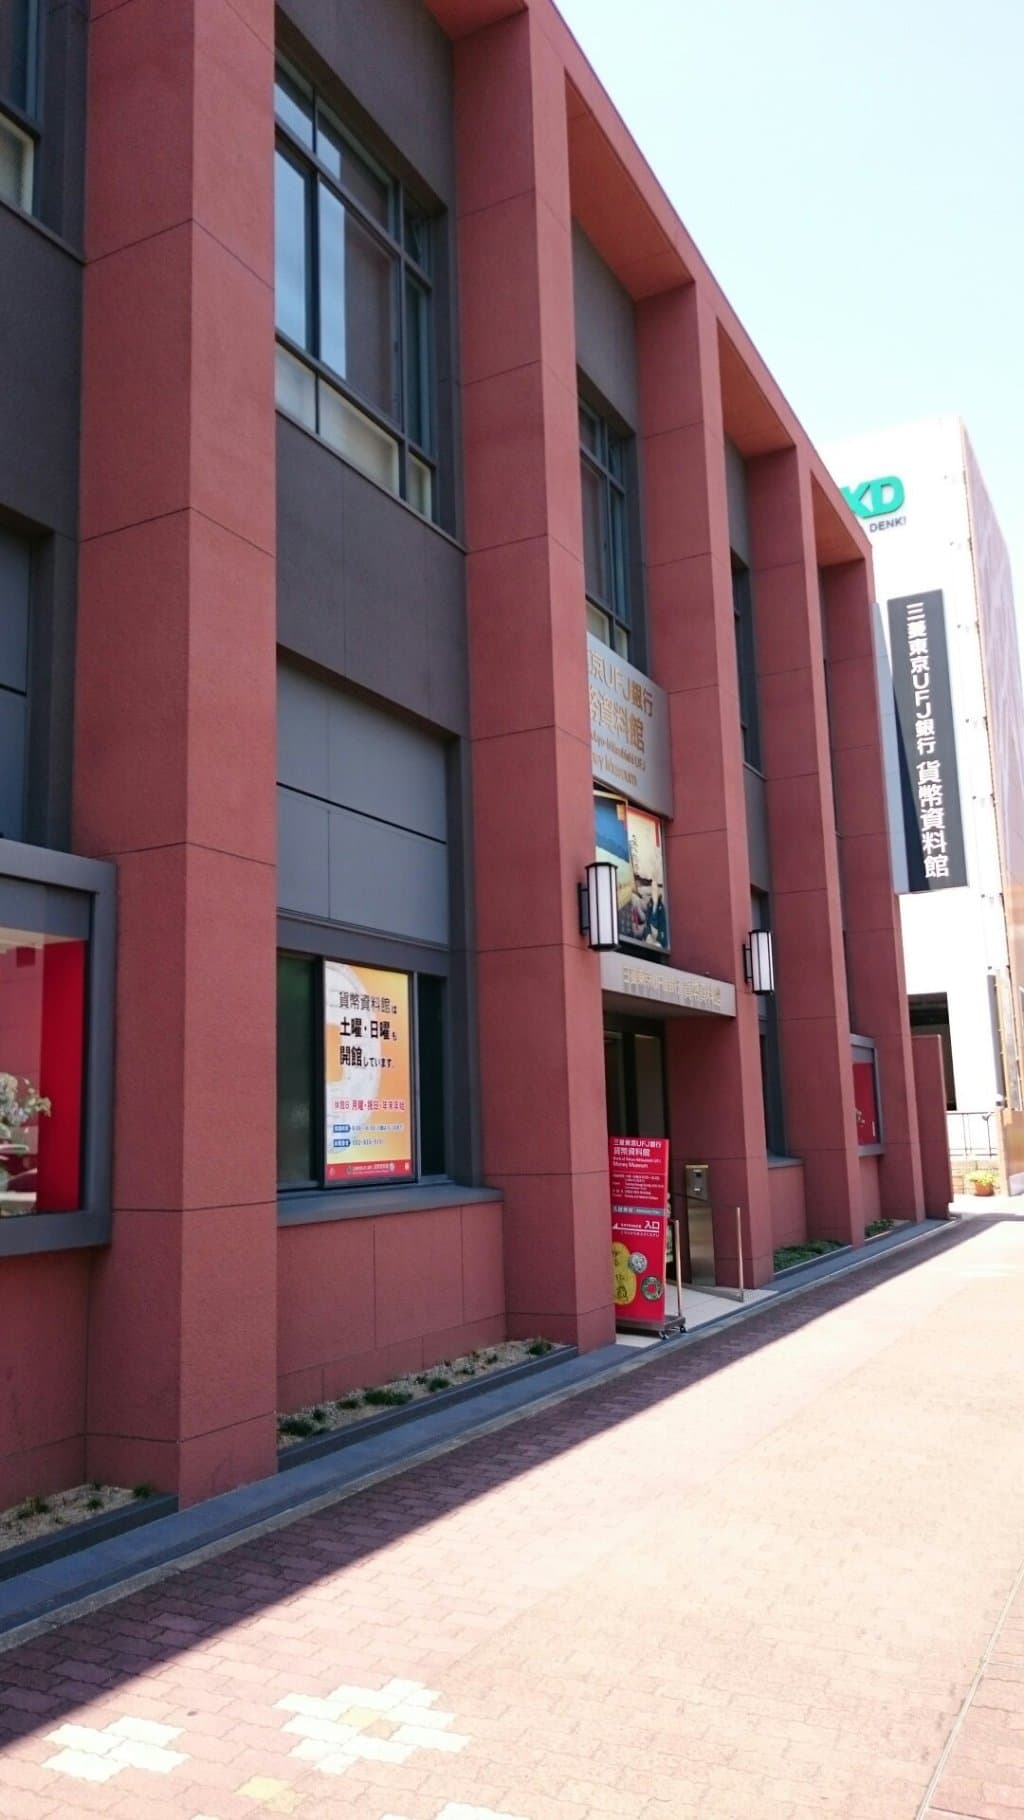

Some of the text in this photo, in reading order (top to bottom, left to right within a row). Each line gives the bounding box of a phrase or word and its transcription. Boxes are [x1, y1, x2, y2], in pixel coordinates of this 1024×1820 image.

[906, 602, 949, 878] 三菱東京UFJ銀行 貨幣資料館
[340, 1017, 397, 1041] 土曜・日曜も
[644, 1220, 660, 1230] 入口
